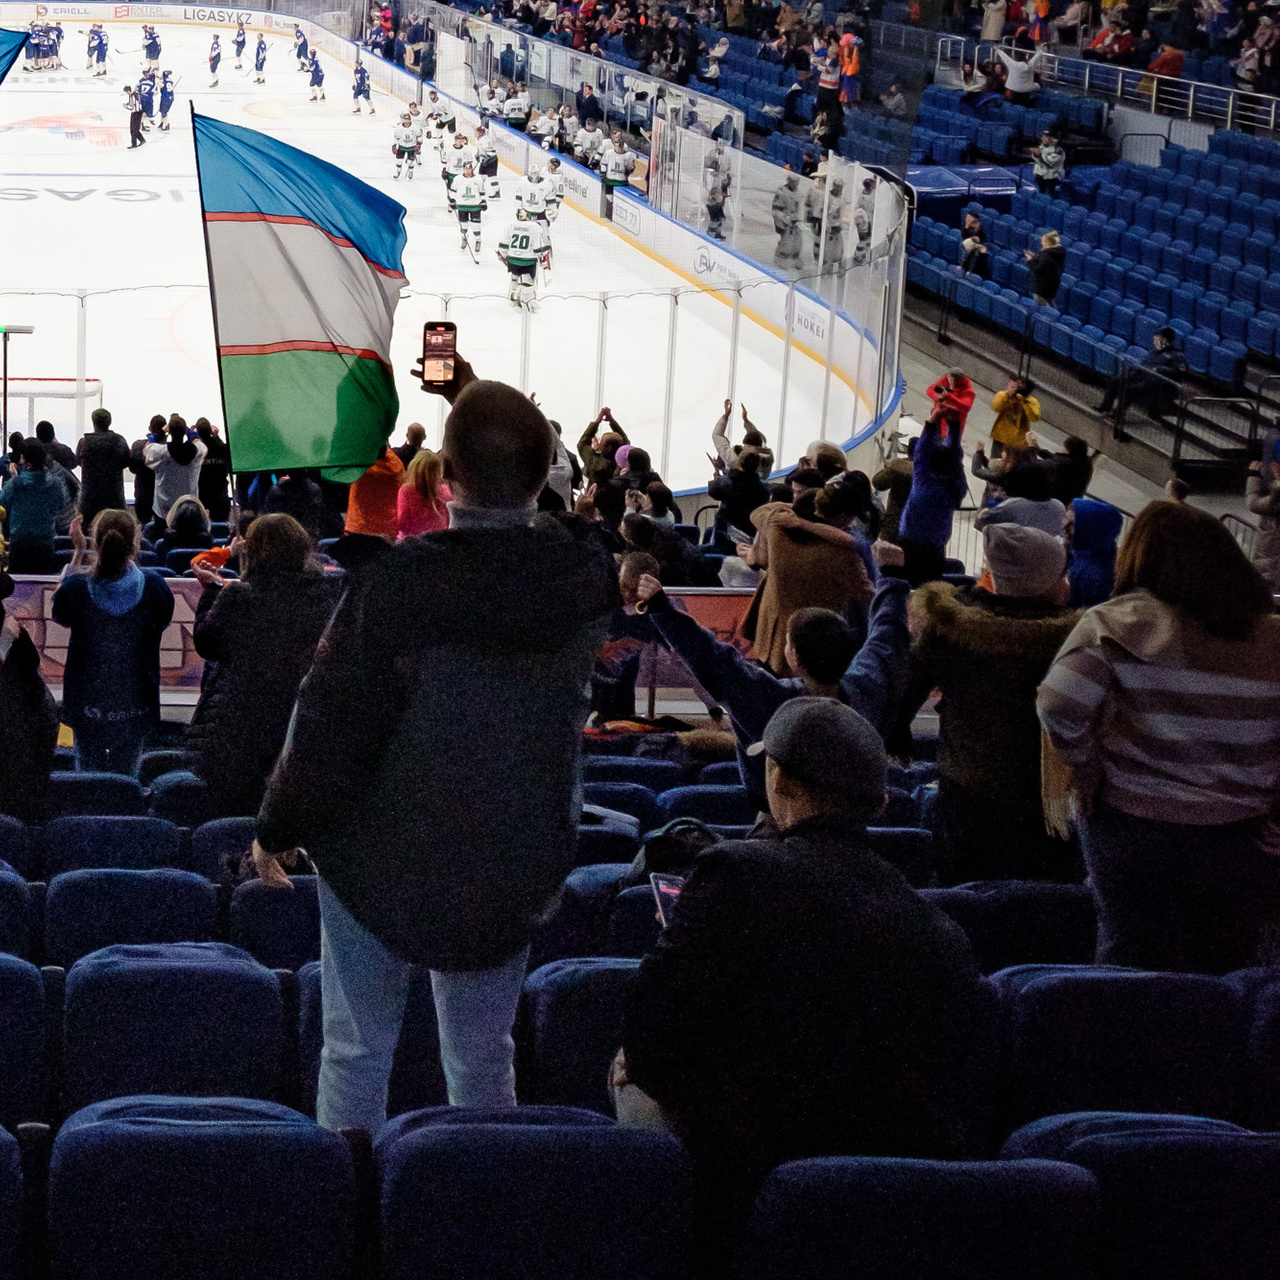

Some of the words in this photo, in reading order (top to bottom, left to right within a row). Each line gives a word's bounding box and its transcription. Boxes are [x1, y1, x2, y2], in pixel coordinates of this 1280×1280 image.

[184, 8, 252, 25] LIGASY.KZ
[510, 233, 530, 250] 20
[797, 313, 824, 339] HOKEI
